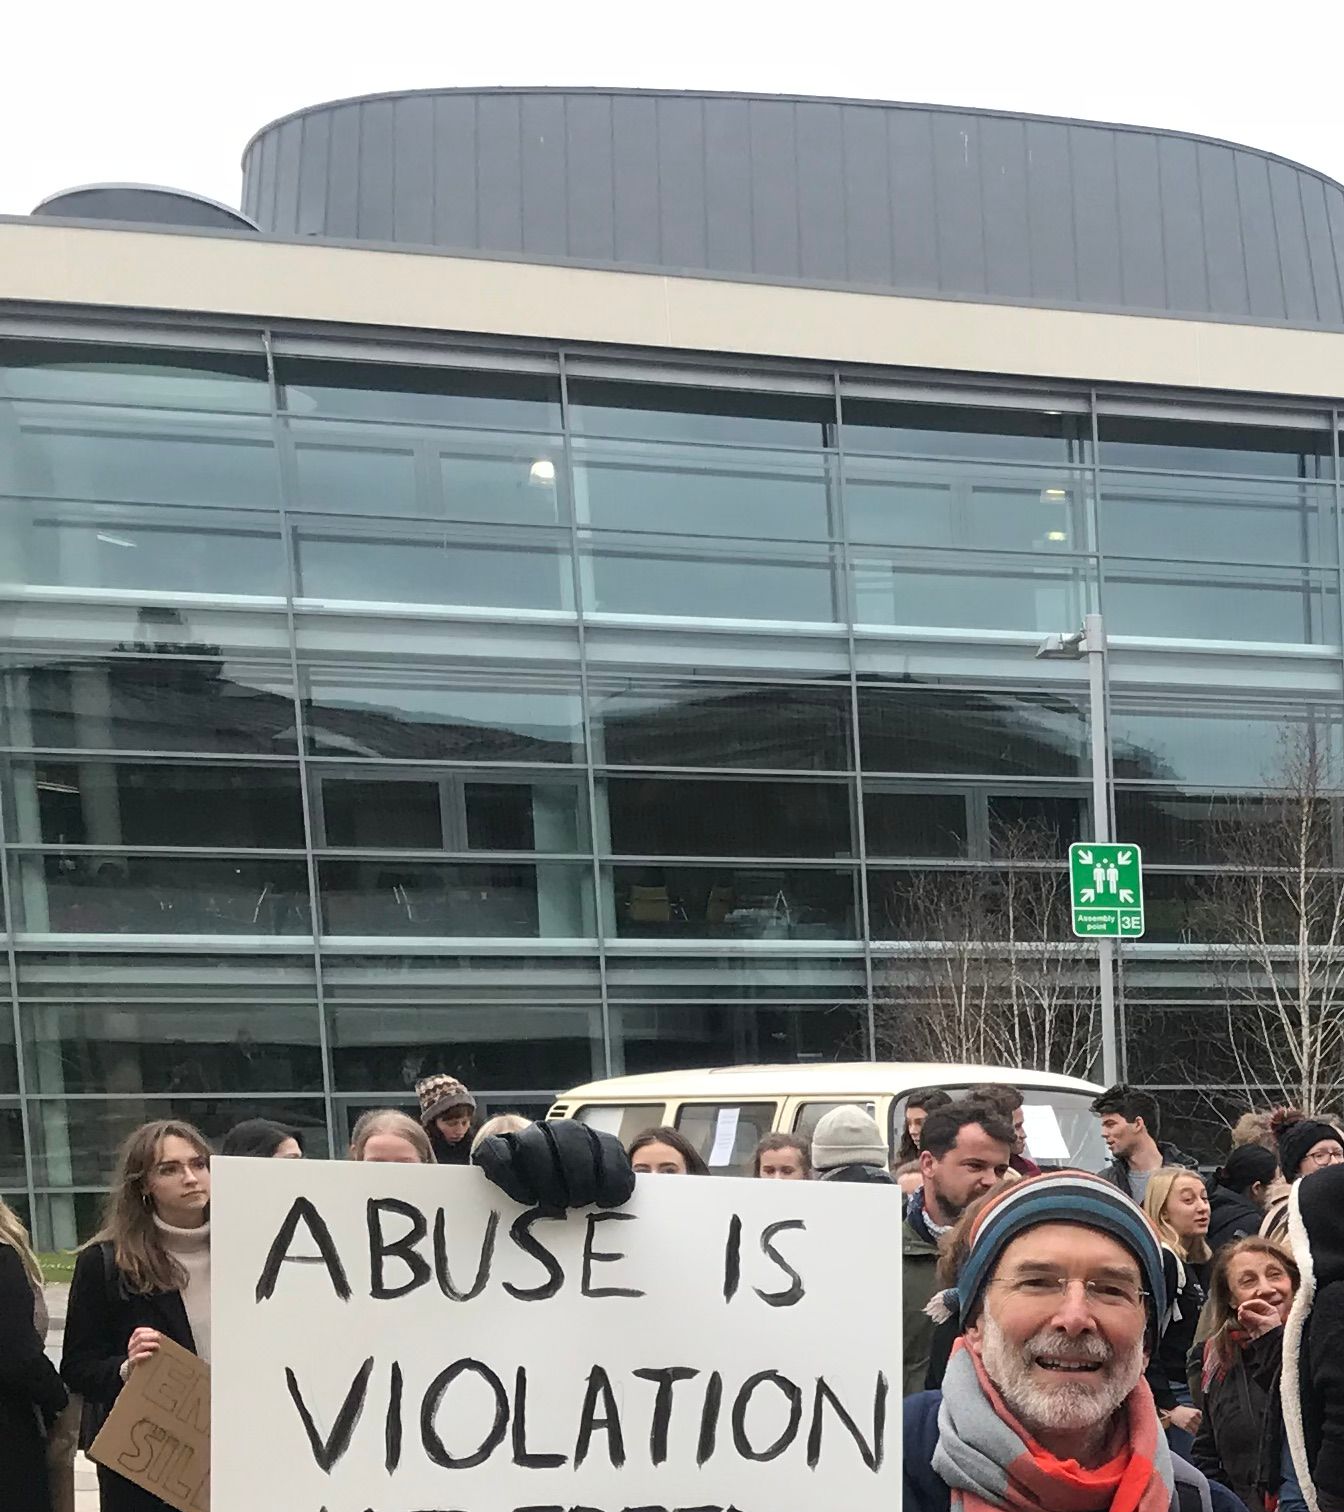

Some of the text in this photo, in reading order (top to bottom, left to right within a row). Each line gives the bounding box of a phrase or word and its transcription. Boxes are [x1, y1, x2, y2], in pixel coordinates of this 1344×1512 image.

[1121, 916, 1141, 930] 3E
[256, 1197, 808, 1307] ABUSE IS
[285, 1357, 889, 1476] VIOLATION
